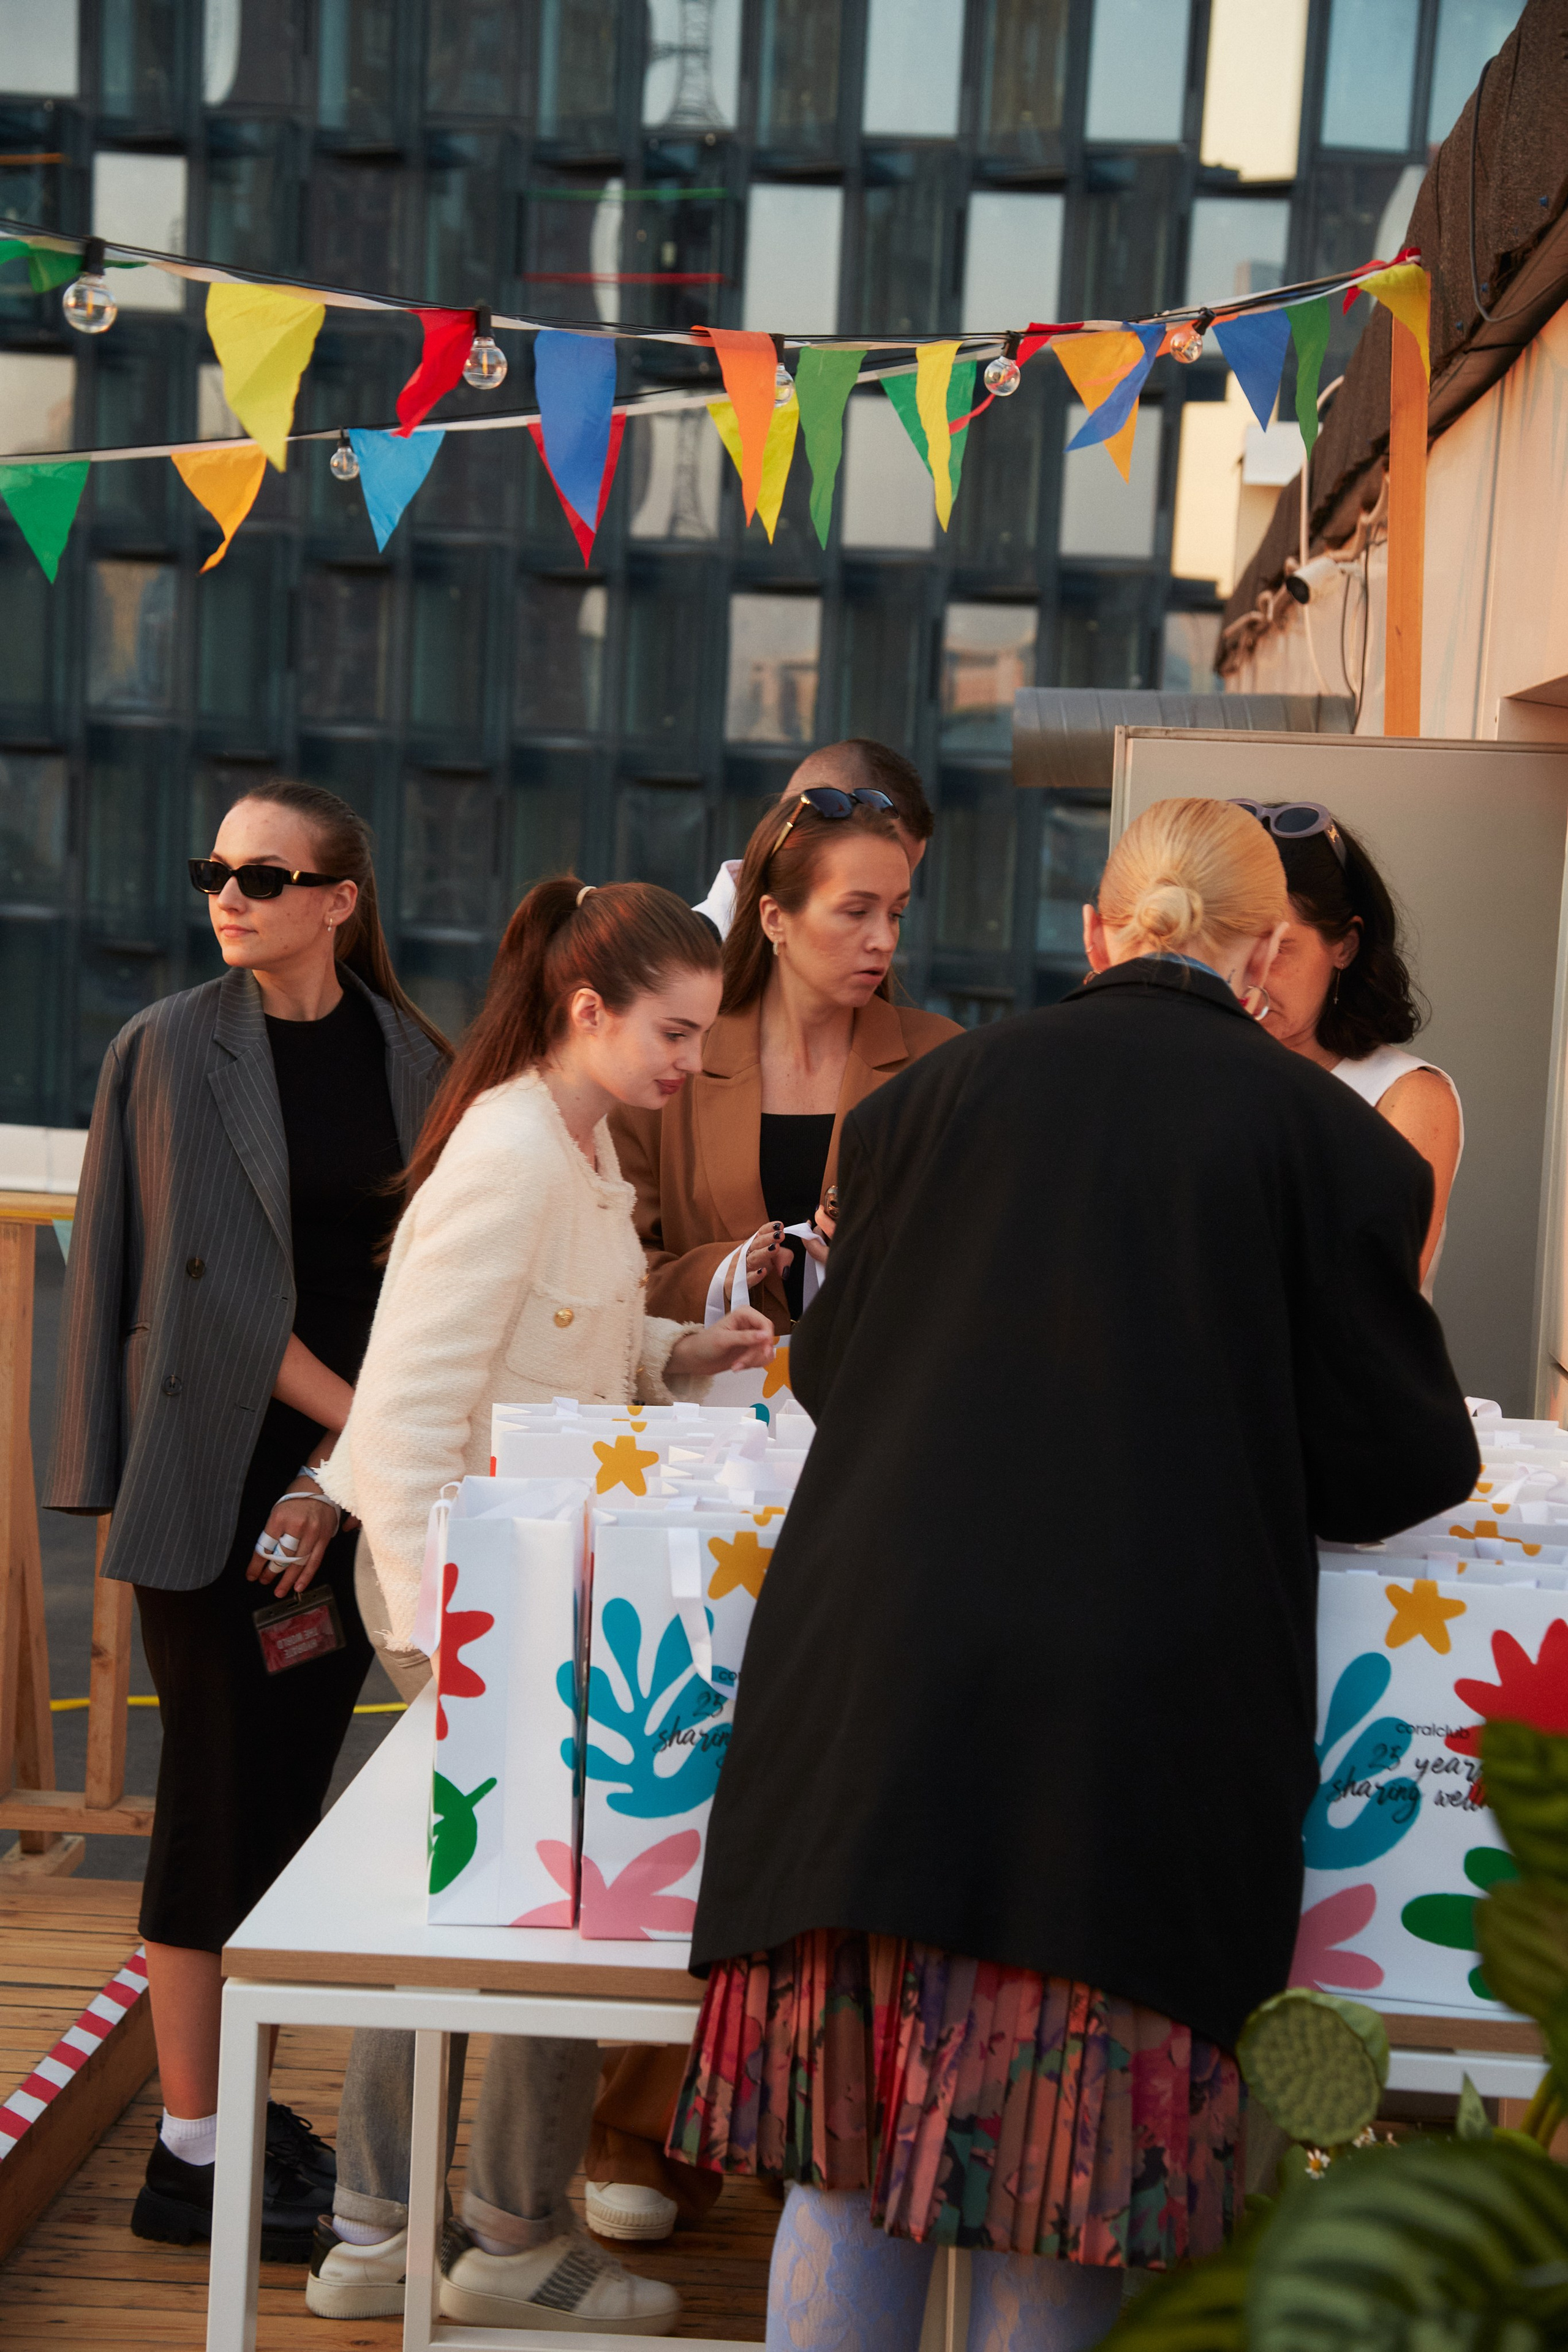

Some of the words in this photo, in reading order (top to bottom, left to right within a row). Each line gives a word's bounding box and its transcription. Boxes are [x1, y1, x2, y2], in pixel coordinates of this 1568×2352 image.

[1396, 1723, 1469, 1739] coralclub
[1326, 1765, 1420, 1823] sharing
[1434, 1782, 1484, 1812] well
